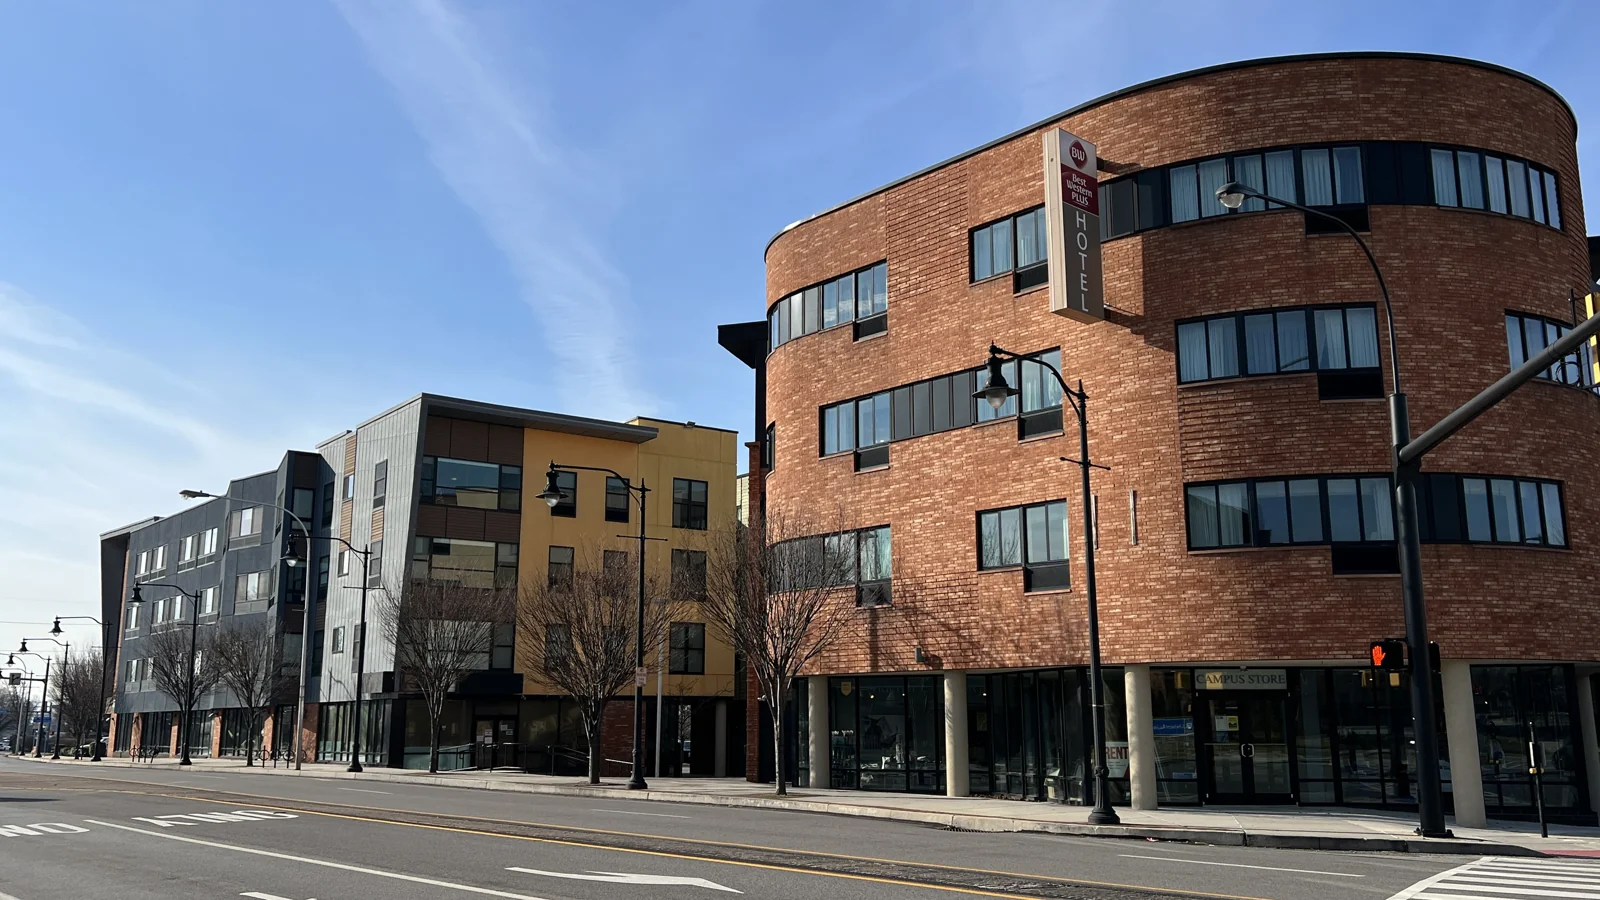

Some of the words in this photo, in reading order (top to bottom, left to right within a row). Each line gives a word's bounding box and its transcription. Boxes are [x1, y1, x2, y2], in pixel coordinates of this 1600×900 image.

[1071, 148, 1085, 162] BW
[1072, 174, 1087, 187] Best
[1066, 179, 1093, 198] Western
[1071, 191, 1089, 206] PLUS
[1076, 210, 1089, 312] HOTEL
[1196, 674, 1245, 684] CAMPUS
[1248, 674, 1285, 684] STORE
